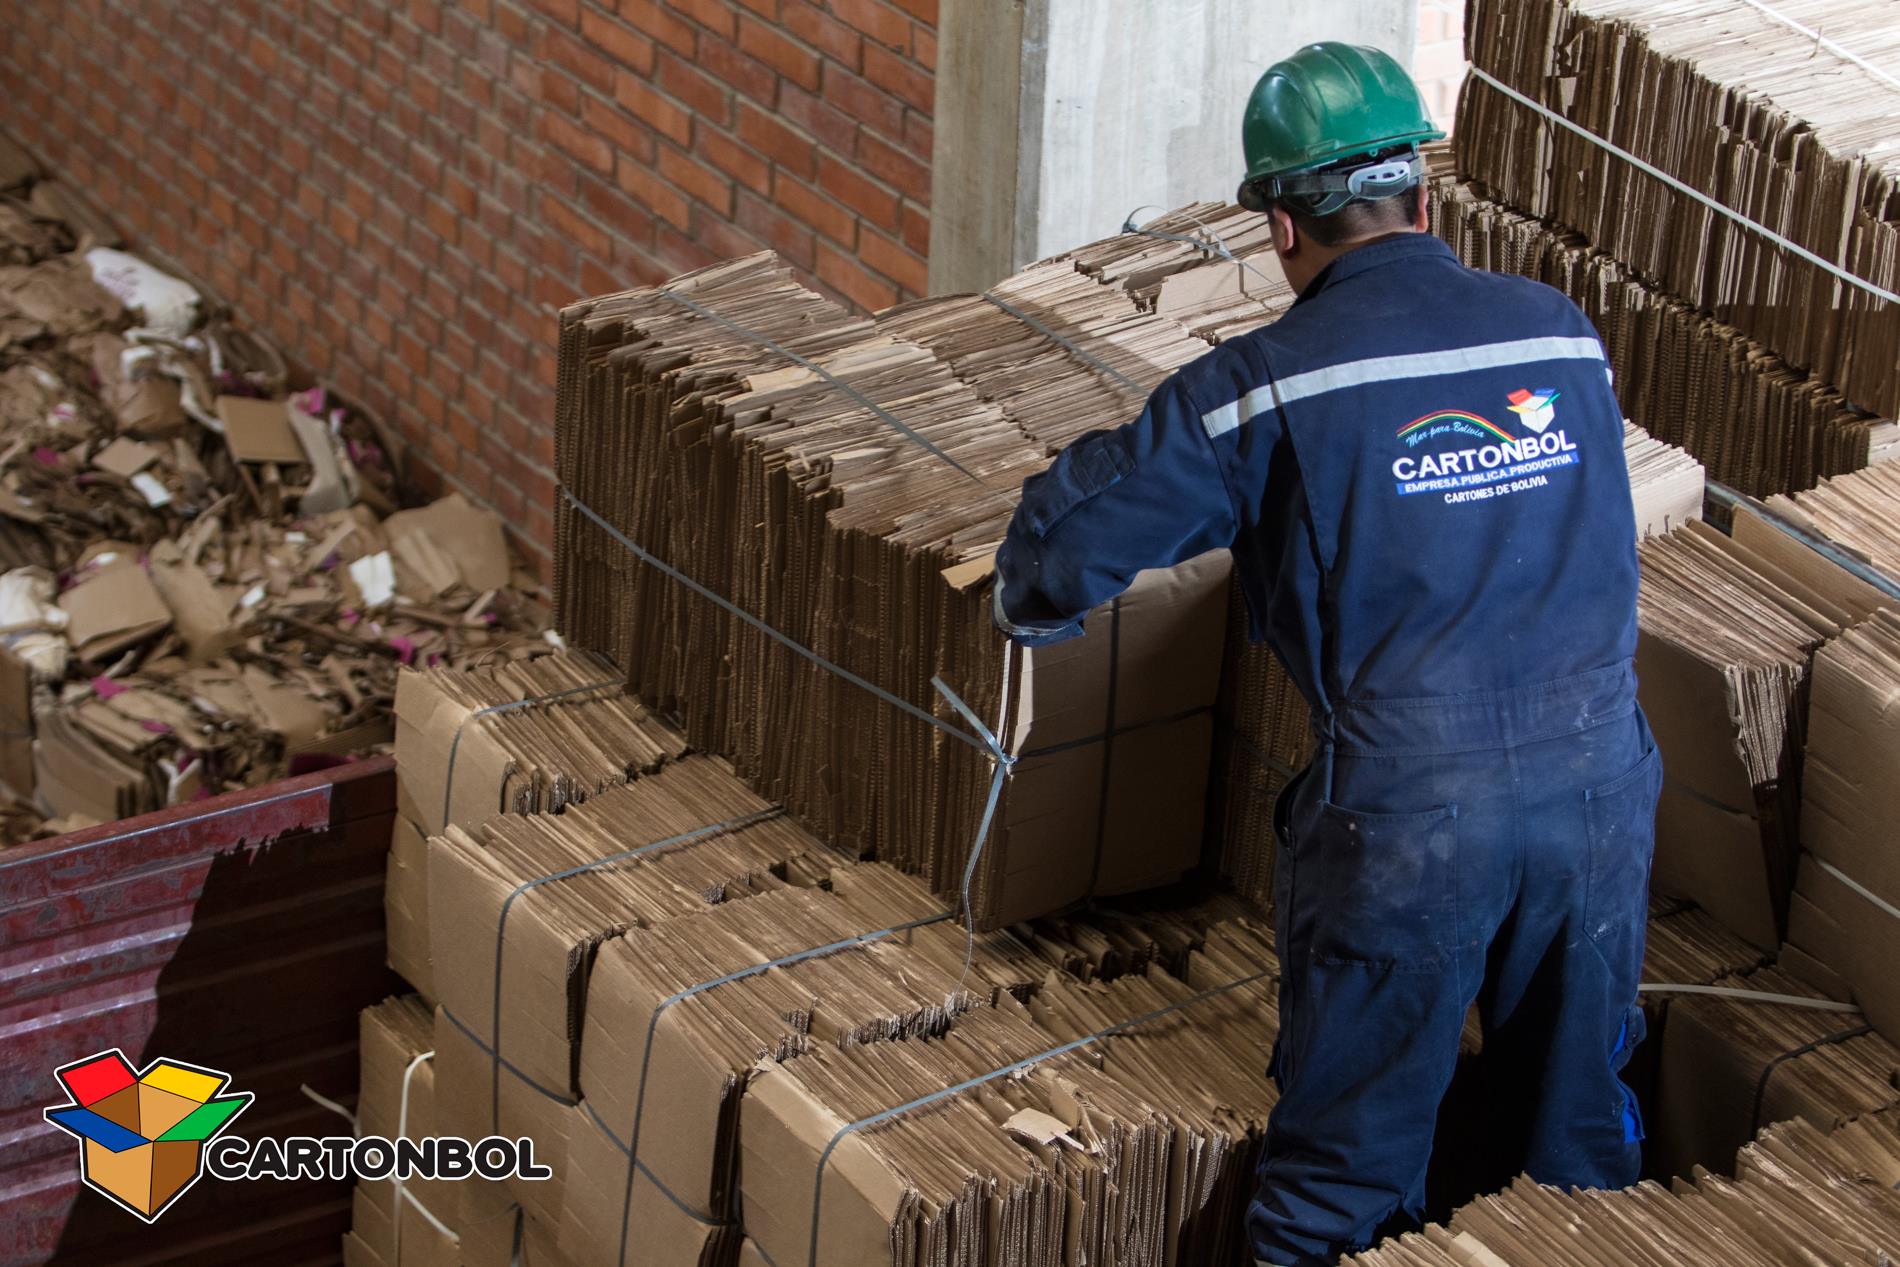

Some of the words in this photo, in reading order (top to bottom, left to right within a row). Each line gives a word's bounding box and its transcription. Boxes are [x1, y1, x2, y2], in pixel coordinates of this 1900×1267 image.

[1430, 425, 1450, 440] para
[1453, 421, 1485, 439] Bolivia
[1392, 430, 1577, 481] CARTONBOL
[1405, 477, 1459, 494] EMPRESA
[1461, 469, 1508, 487] PUBLICA
[1510, 454, 1573, 477] PRODUCTIVA
[1444, 488, 1495, 505] CARTONES
[1497, 484, 1511, 497] DE
[1512, 475, 1549, 492] BOLIVIA
